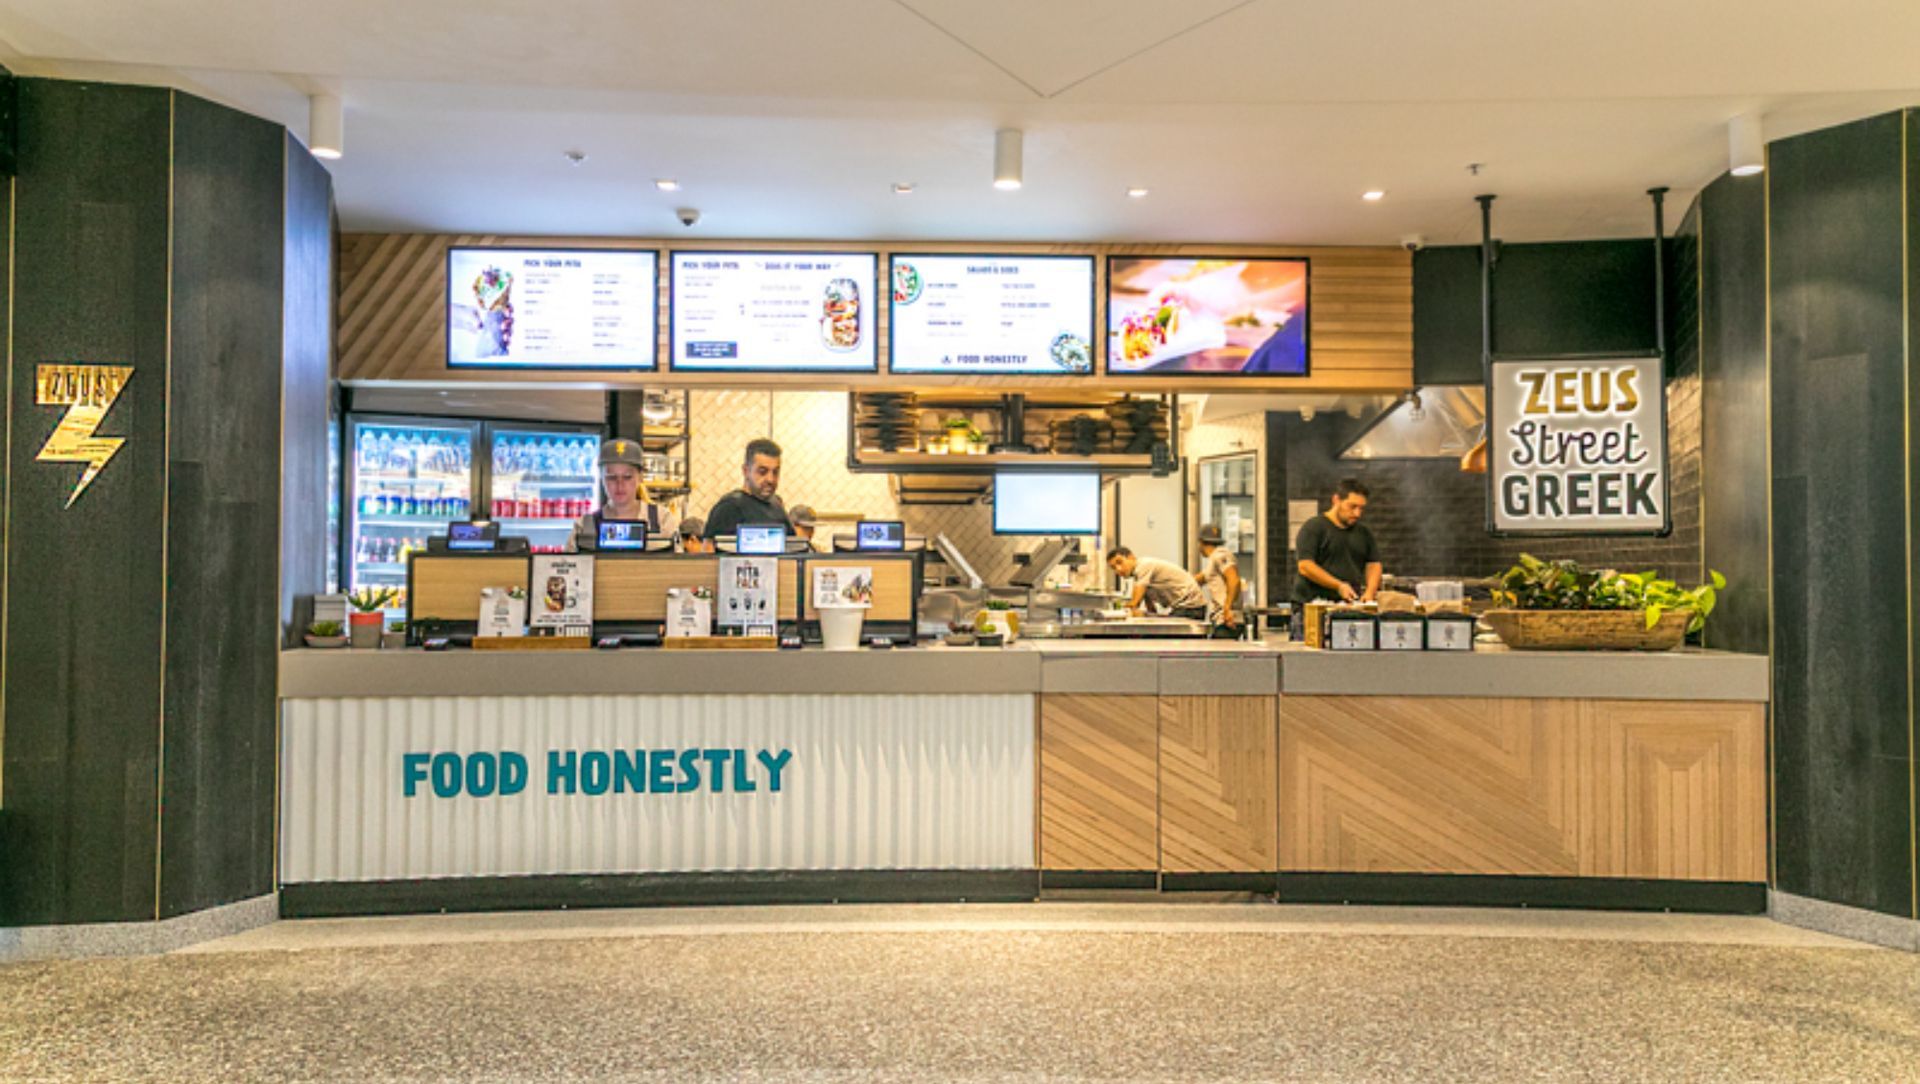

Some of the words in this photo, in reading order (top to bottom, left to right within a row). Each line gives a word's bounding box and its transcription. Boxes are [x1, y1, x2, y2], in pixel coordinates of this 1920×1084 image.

[957, 355, 980, 364] FOOD
[51, 372, 106, 398] ZEUS
[1519, 370, 1639, 414] ZEUS
[1510, 421, 1648, 465] Street
[1502, 473, 1659, 517] GREEK
[736, 566, 759, 577] PITA
[403, 752, 529, 798] FOOD
[547, 748, 793, 796] HONESTLY
